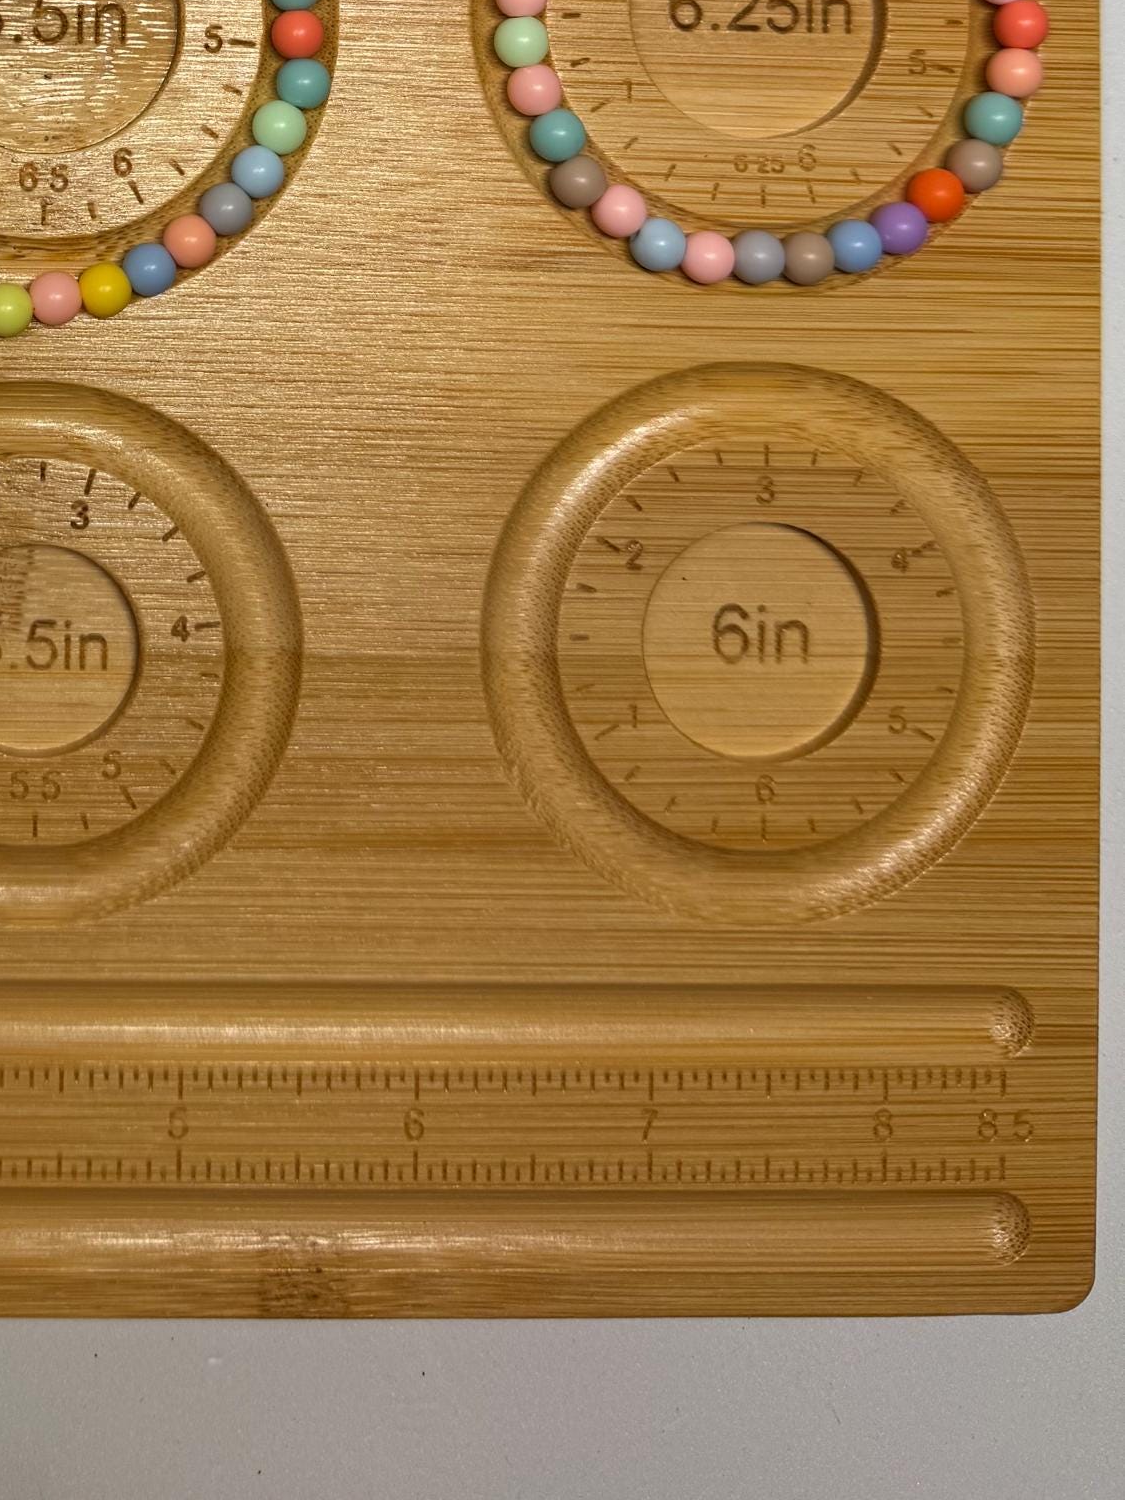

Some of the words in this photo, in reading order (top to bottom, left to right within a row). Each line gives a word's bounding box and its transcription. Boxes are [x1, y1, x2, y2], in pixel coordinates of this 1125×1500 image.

[204, 26, 223, 54] 5
[908, 49, 927, 76] 5
[113, 147, 132, 177] 6
[798, 144, 816, 172] 6
[756, 475, 775, 505] 3
[70, 500, 89, 530] 3
[626, 540, 643, 570] 2
[892, 548, 909, 573] 4
[171, 616, 189, 641] 4
[712, 603, 810, 664] 6in
[888, 706, 907, 734] 5
[101, 750, 121, 780] 5
[756, 775, 775, 804] 6
[167, 1106, 188, 1140] 5
[403, 1108, 425, 1141] 6
[640, 1108, 659, 1142] 7
[873, 1108, 894, 1141] 8
